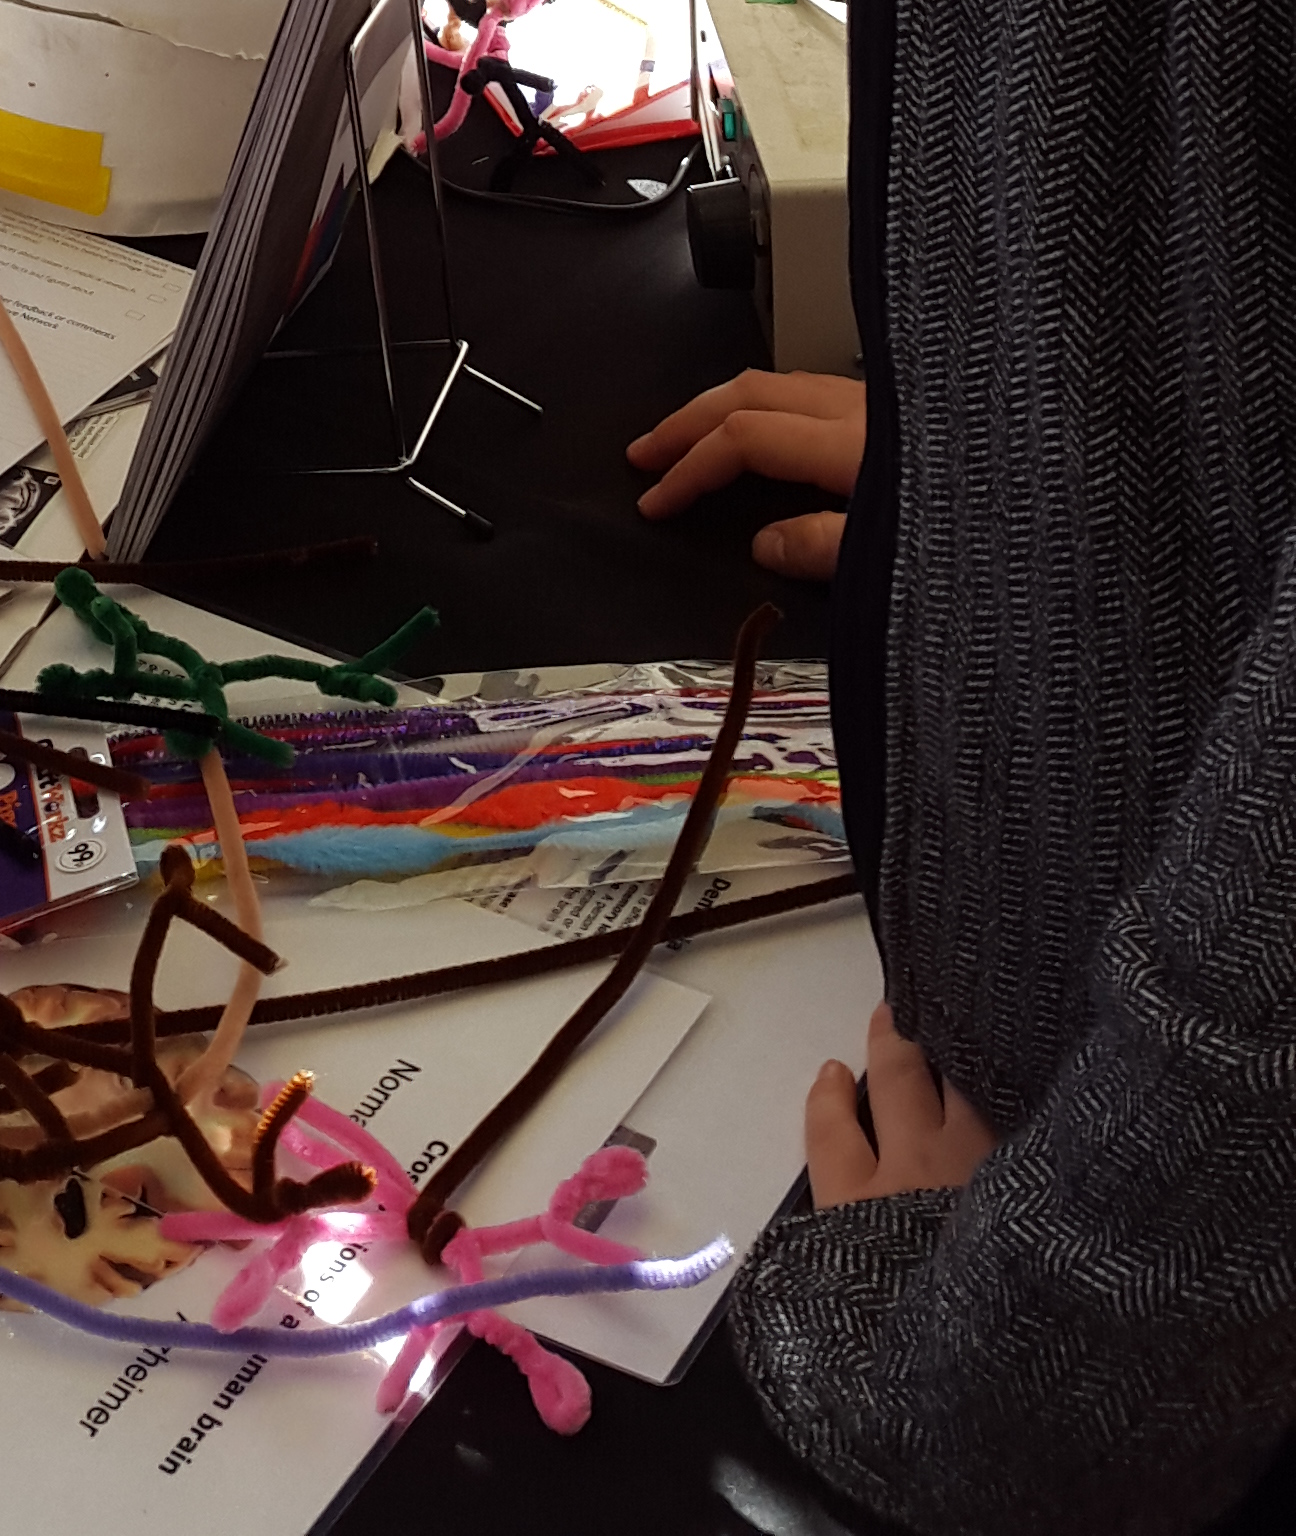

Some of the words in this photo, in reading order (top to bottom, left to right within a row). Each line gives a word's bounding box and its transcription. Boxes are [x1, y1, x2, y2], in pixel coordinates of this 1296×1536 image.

[66, 319, 115, 339] comments
[348, 1057, 423, 1131] Norma
[159, 1413, 219, 1473] brain
